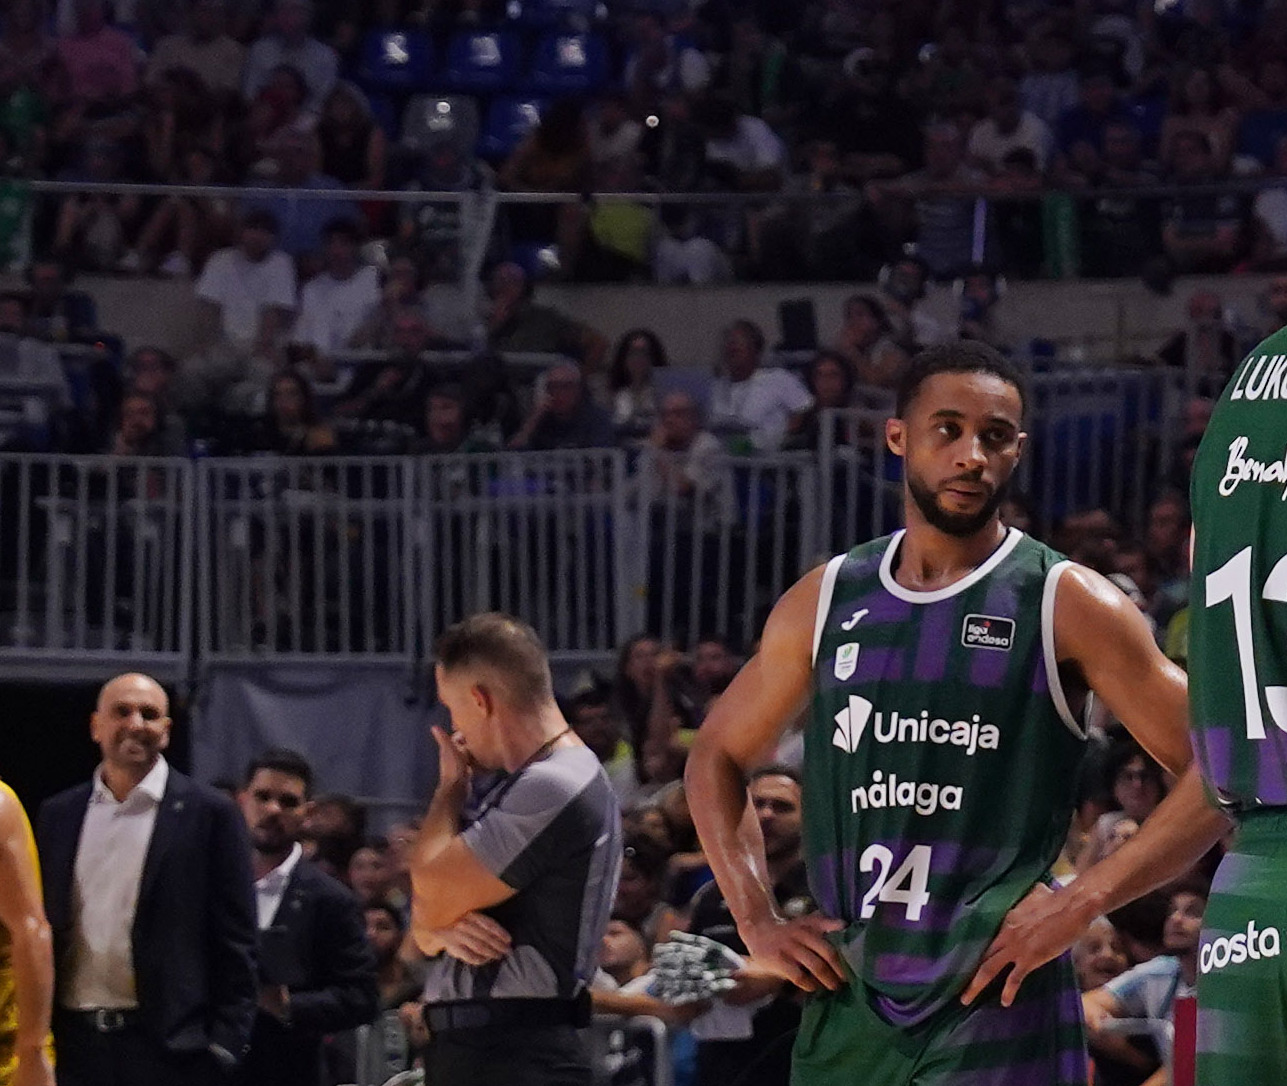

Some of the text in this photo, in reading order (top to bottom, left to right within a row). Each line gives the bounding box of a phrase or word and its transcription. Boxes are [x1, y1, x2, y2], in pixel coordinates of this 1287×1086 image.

[873, 709, 1000, 756] Unicaja
[859, 843, 932, 922] 24
[1200, 920, 1281, 975] costa
